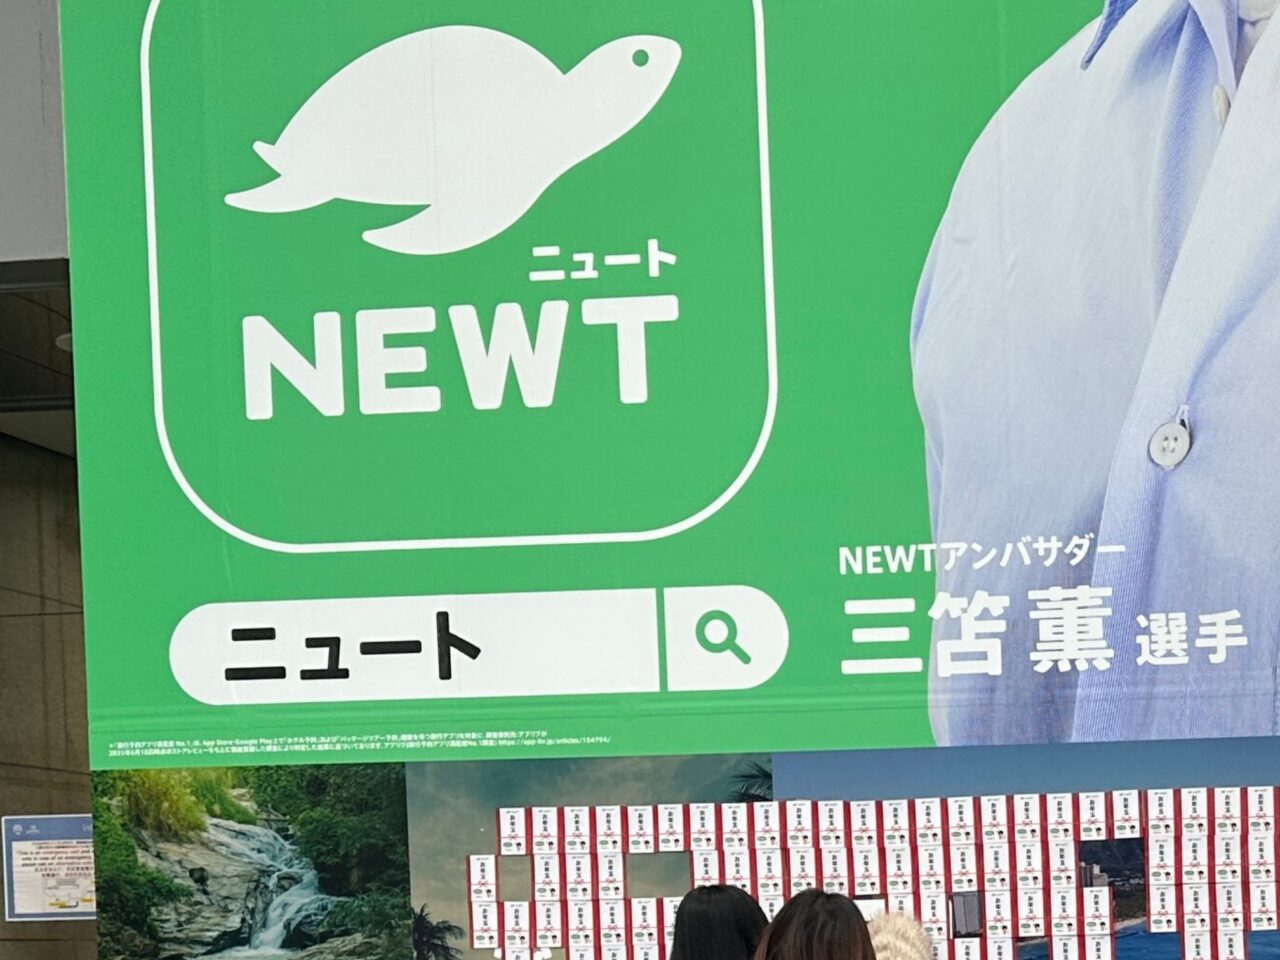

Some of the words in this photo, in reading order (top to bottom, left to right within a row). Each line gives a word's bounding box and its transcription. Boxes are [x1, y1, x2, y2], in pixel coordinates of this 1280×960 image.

[528, 238, 677, 282] ニュート
[241, 294, 680, 421] NEWT
[838, 532, 1126, 575] NEWTアンバサダー
[223, 610, 483, 682] ニュート
[1027, 586, 1115, 674] 薫
[1135, 609, 1249, 666] 選手
